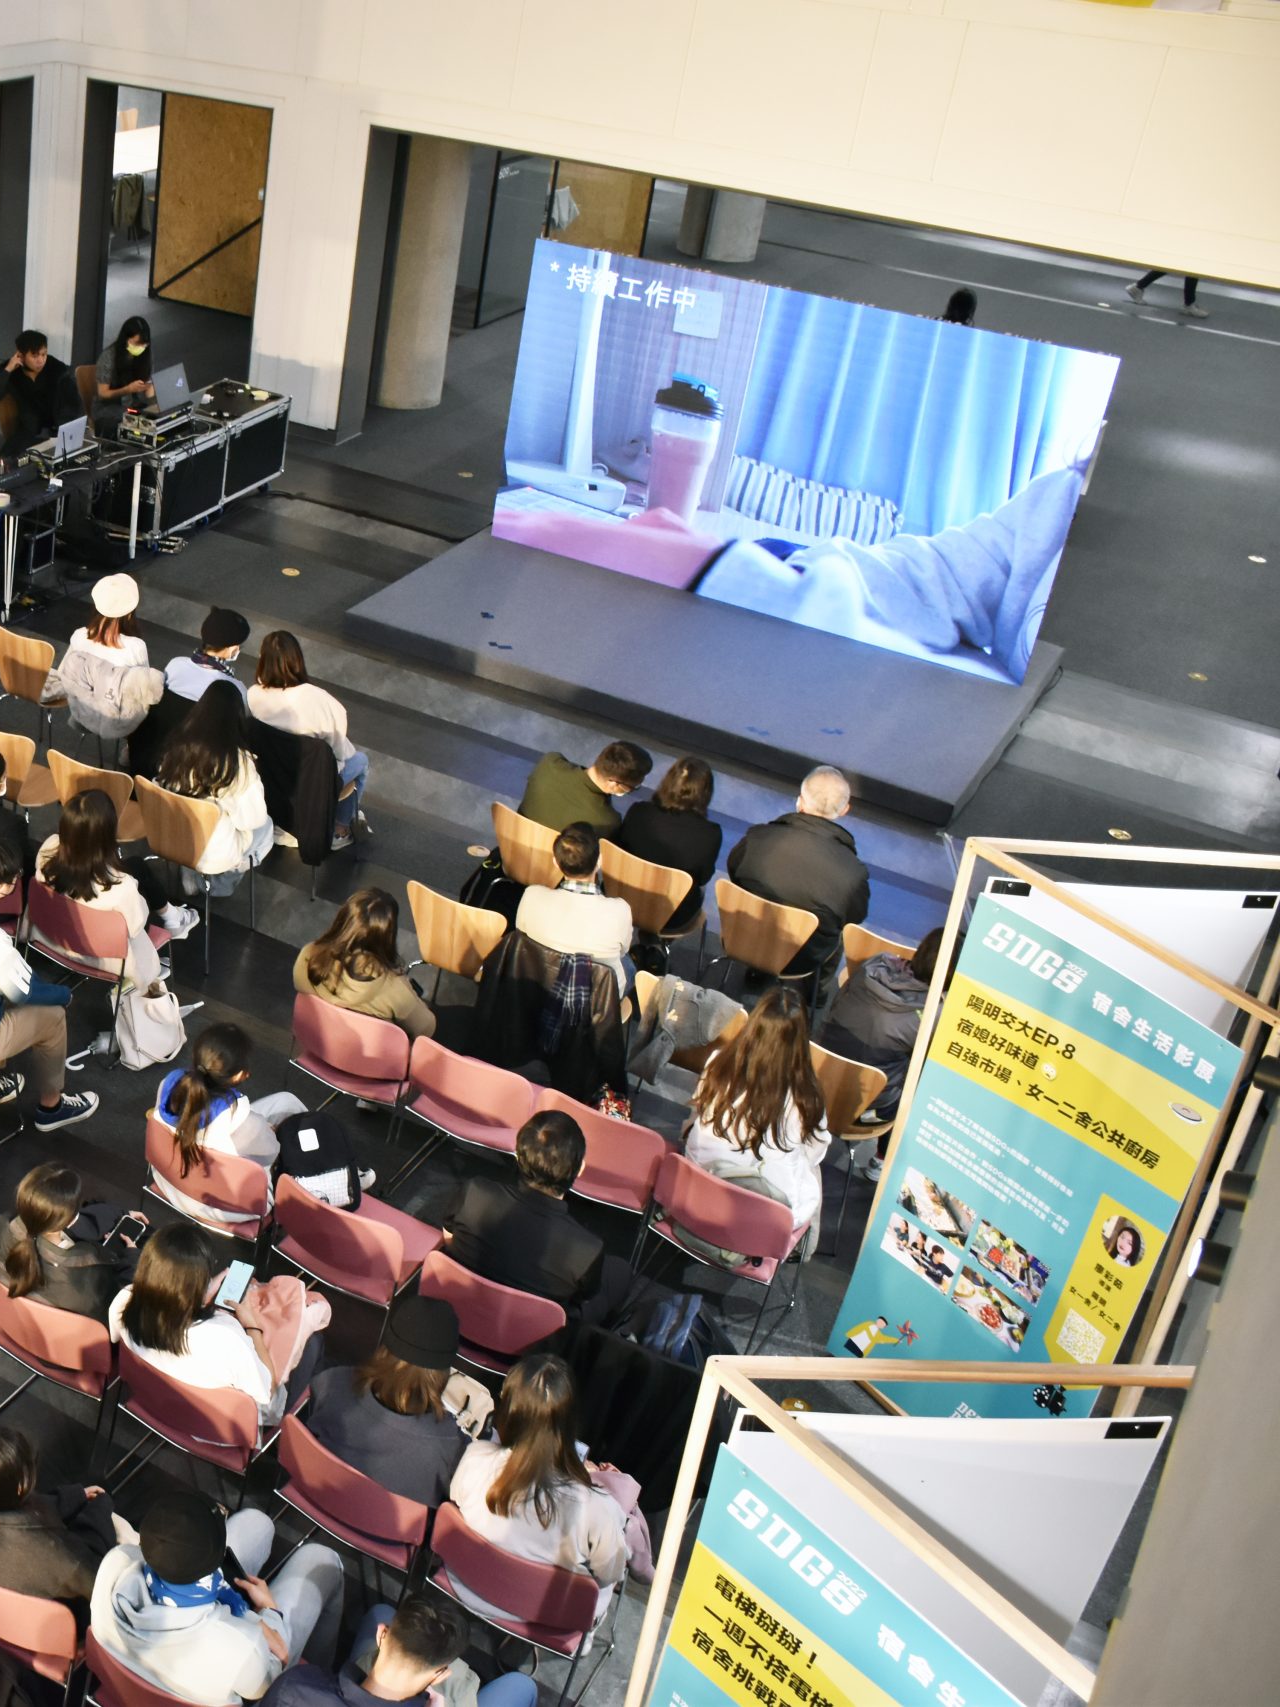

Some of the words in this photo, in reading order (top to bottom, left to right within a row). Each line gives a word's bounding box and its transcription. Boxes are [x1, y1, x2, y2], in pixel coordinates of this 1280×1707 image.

[566, 263, 696, 314] 持續工作中
[1065, 960, 1089, 978] 2022
[956, 1018, 1041, 1071] 宿媳好味道
[966, 994, 1077, 1061] 陽明交大EP.8
[1092, 991, 1217, 1085] 宿舍生活影展
[835, 1570, 868, 1600] 2022
